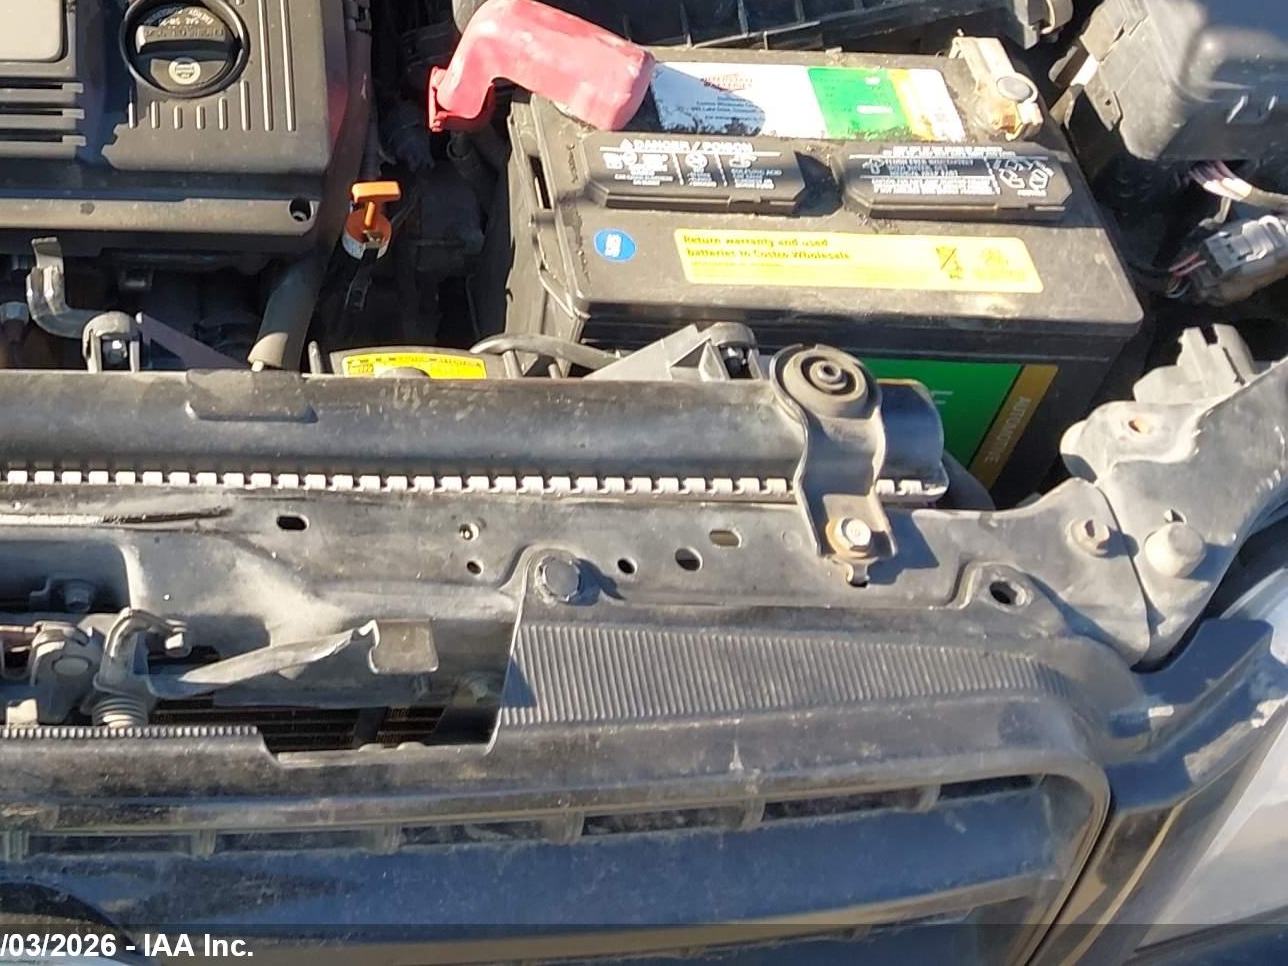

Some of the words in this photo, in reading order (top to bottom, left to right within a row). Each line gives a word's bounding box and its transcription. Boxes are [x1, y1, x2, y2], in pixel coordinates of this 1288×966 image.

[633, 139, 689, 152] DANGER
[725, 238, 774, 248] warranty
[778, 238, 799, 247] and
[802, 239, 829, 247] used
[687, 249, 735, 258] batteries
[792, 251, 850, 260] Wholesale
[984, 395, 1032, 464] AUTOMOTIVE
